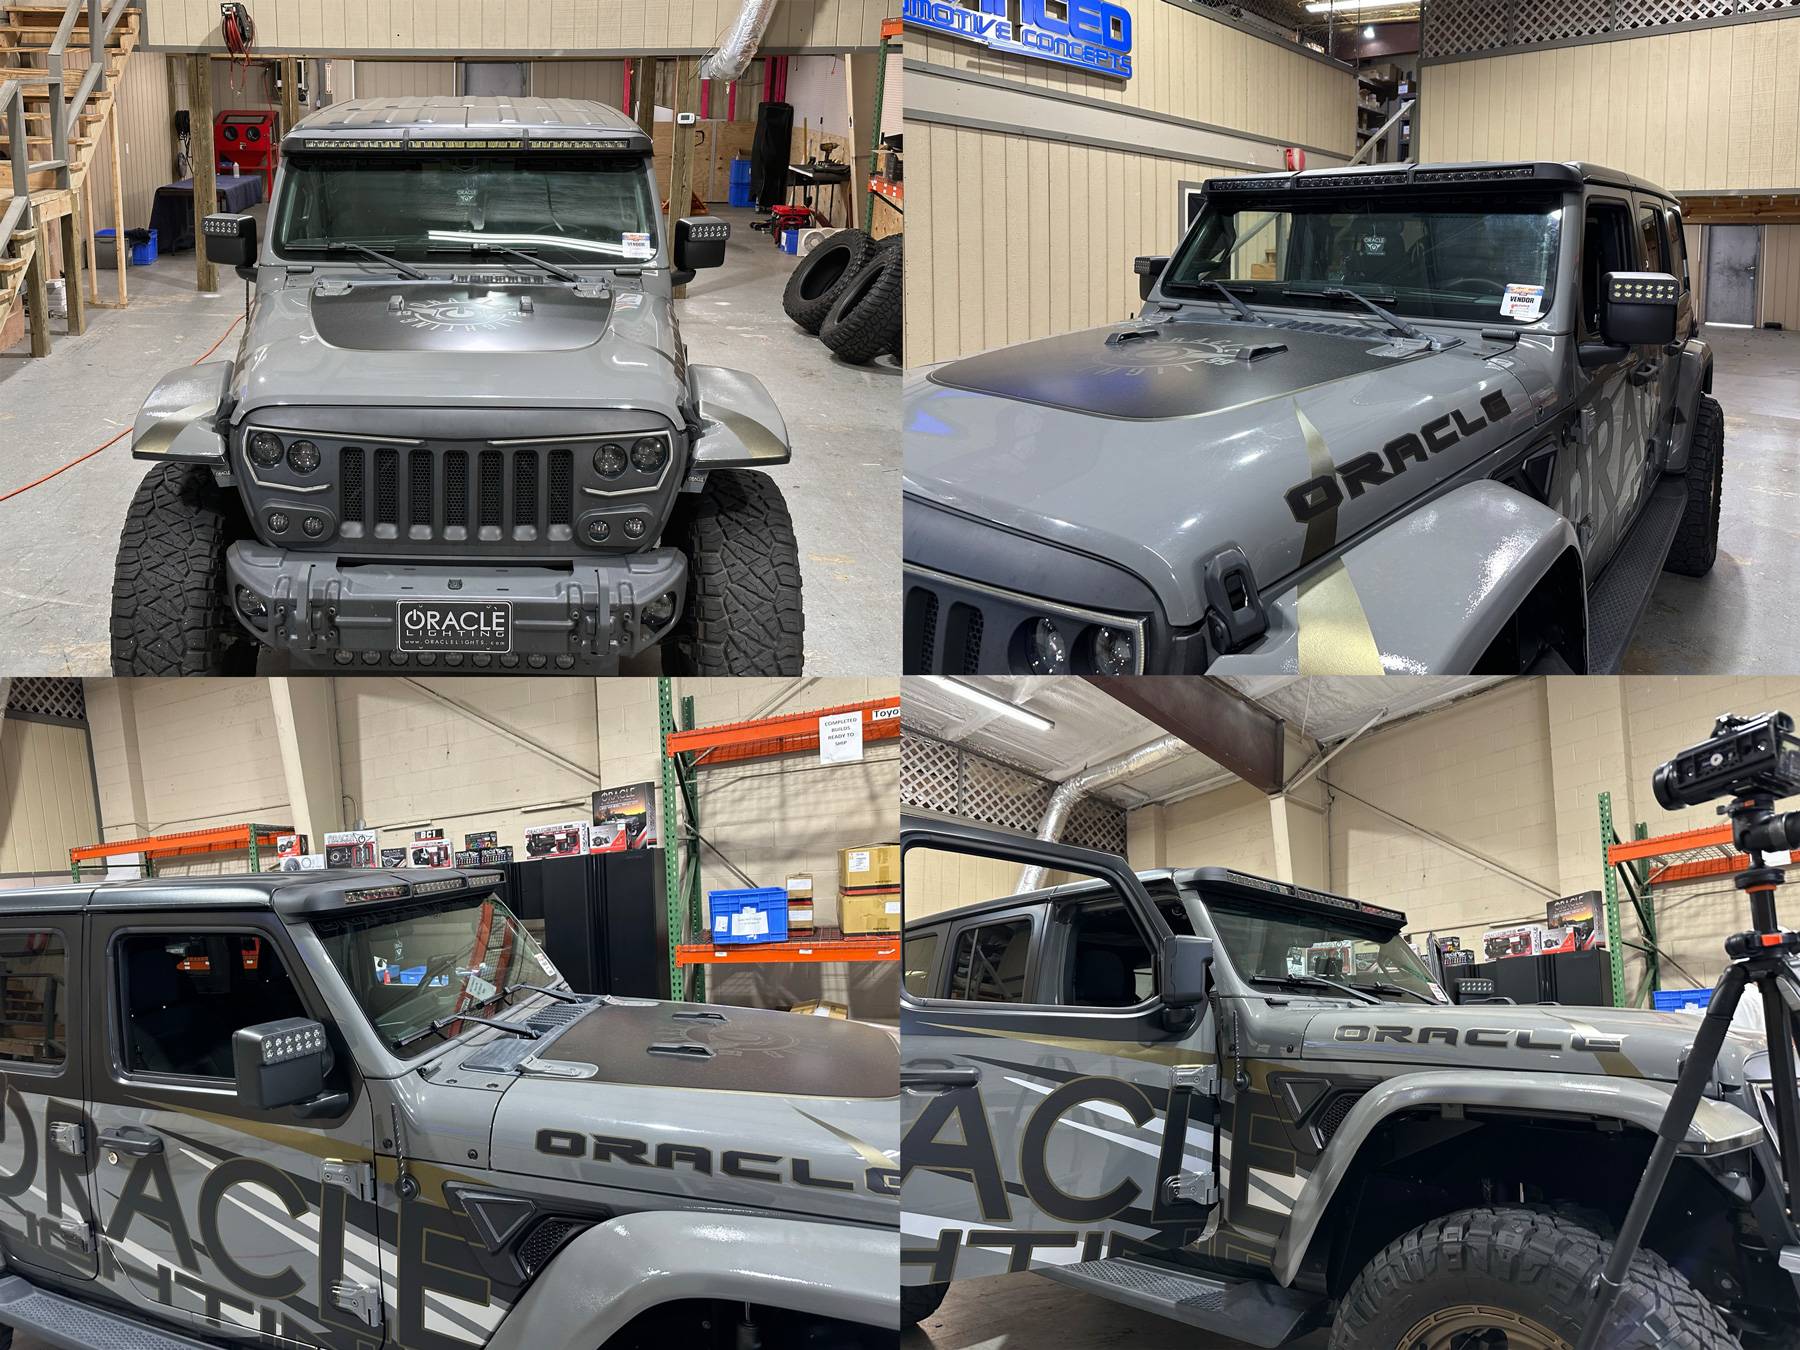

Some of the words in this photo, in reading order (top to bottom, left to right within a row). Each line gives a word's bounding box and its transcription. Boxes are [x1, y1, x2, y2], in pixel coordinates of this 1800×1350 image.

[903, 0, 1011, 40] MOTIVE
[1022, 28, 1132, 75] CONCEPTS
[1283, 388, 1511, 523] ORACLE
[404, 608, 505, 630] ORACLE
[824, 718, 857, 726] COMPLETED
[873, 708, 899, 718] Toyo
[601, 786, 636, 802] ORACLE
[420, 830, 436, 839] BC1
[1333, 1024, 1630, 1053] ORACLE
